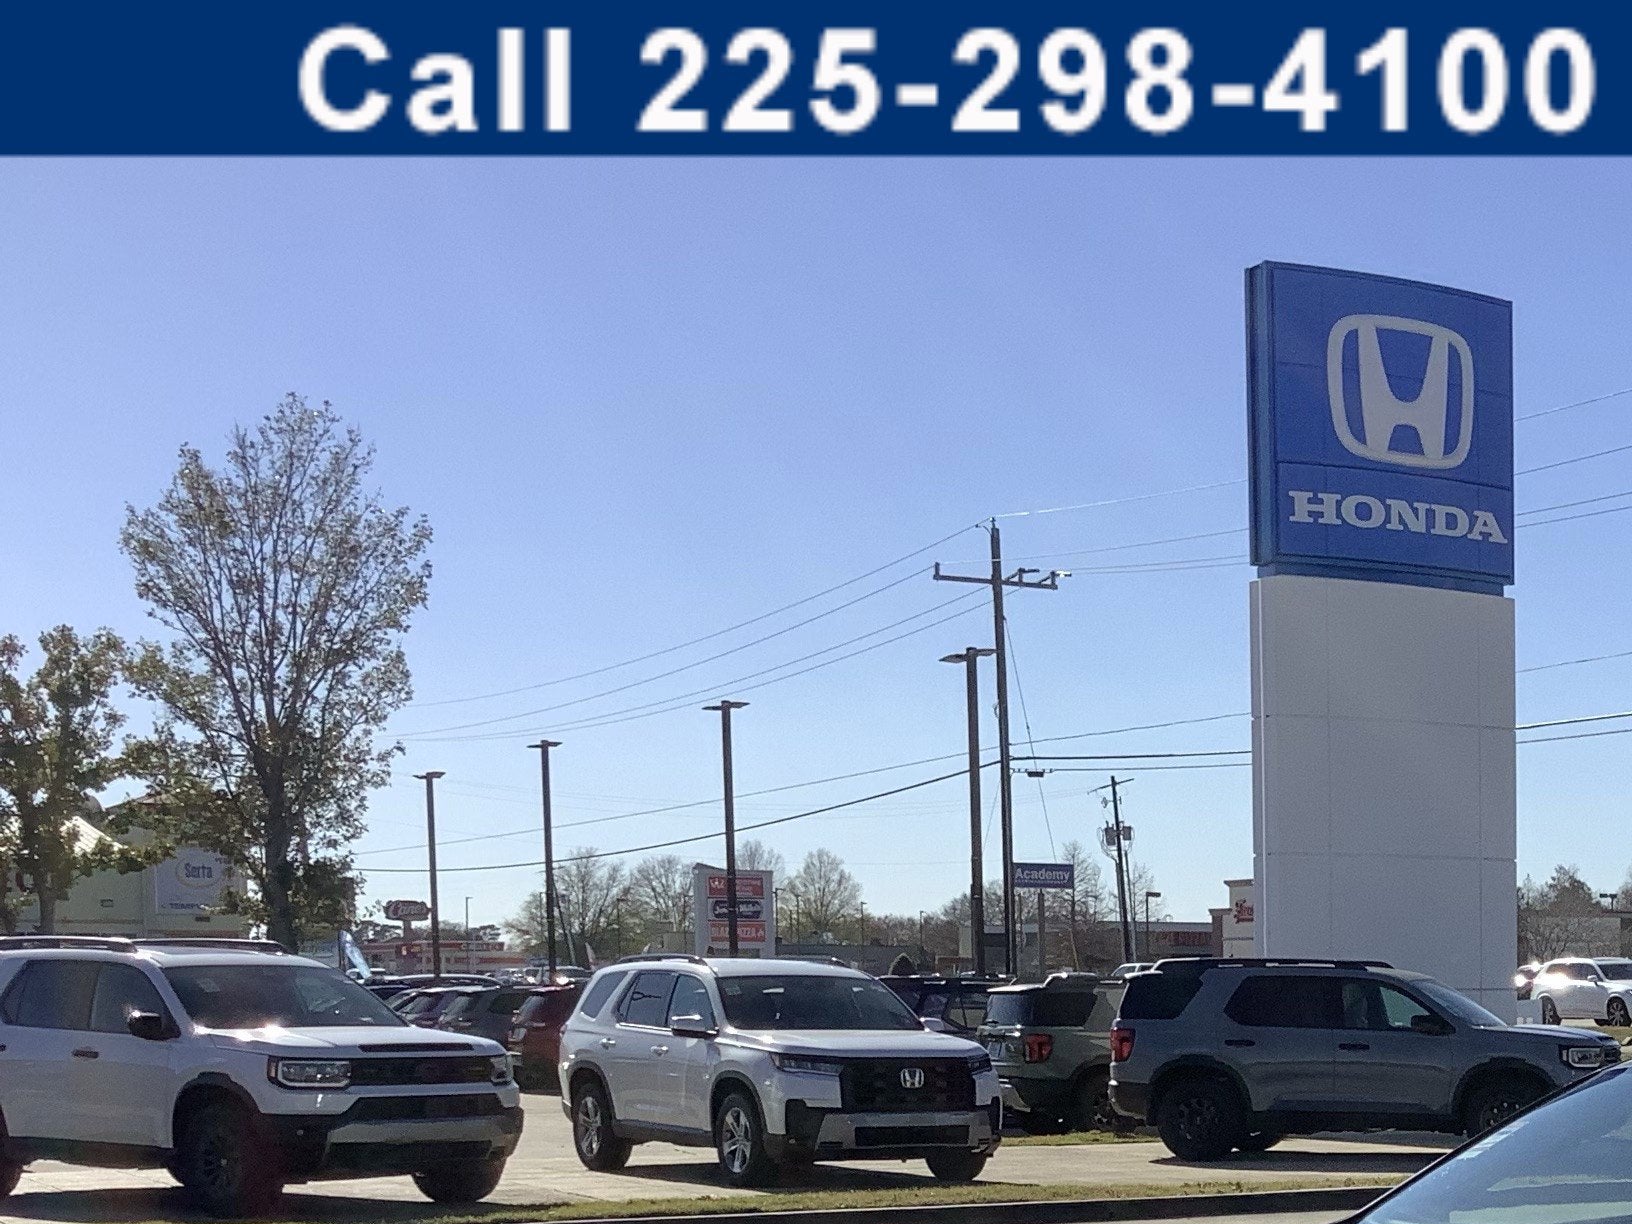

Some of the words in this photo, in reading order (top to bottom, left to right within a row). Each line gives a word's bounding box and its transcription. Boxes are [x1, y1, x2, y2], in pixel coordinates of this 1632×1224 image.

[1288, 490, 1508, 544] HONDA
[184, 863, 213, 879] Serta
[1015, 868, 1070, 883] Academy
